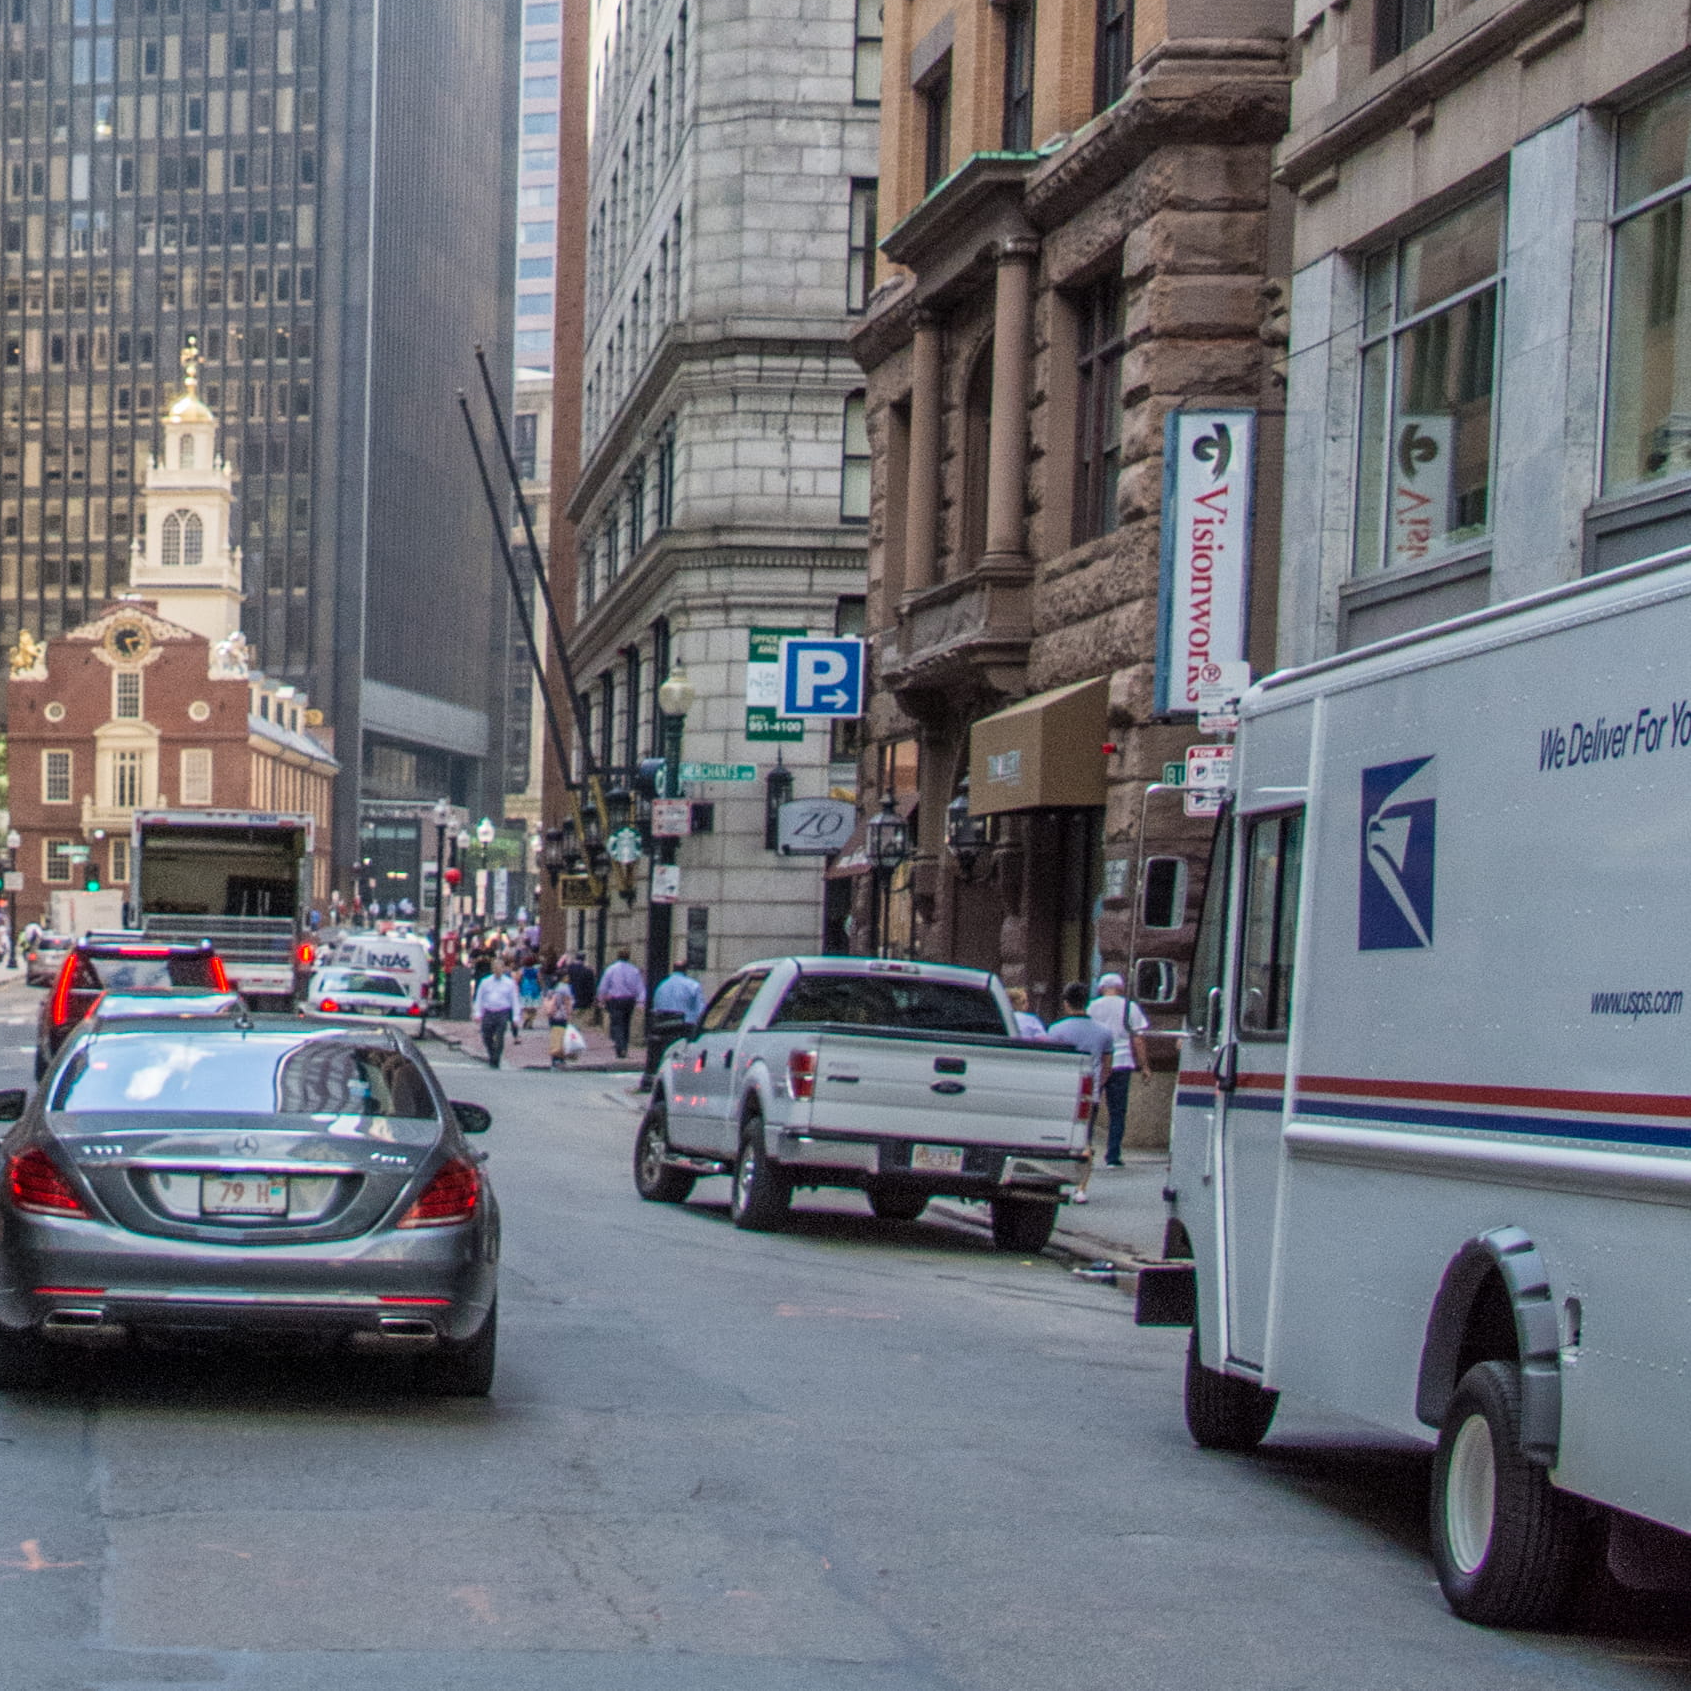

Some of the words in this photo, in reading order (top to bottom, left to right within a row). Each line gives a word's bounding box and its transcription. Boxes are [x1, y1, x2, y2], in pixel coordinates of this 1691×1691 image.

[795, 649, 848, 707] P
[1539, 727, 1566, 772] We
[1567, 717, 1632, 766] Deliver
[1633, 708, 1668, 755] For
[1671, 699, 1691, 748] Yo
[1591, 990, 1684, 1022] www.usps.com
[221, 1180, 246, 1203] 79
